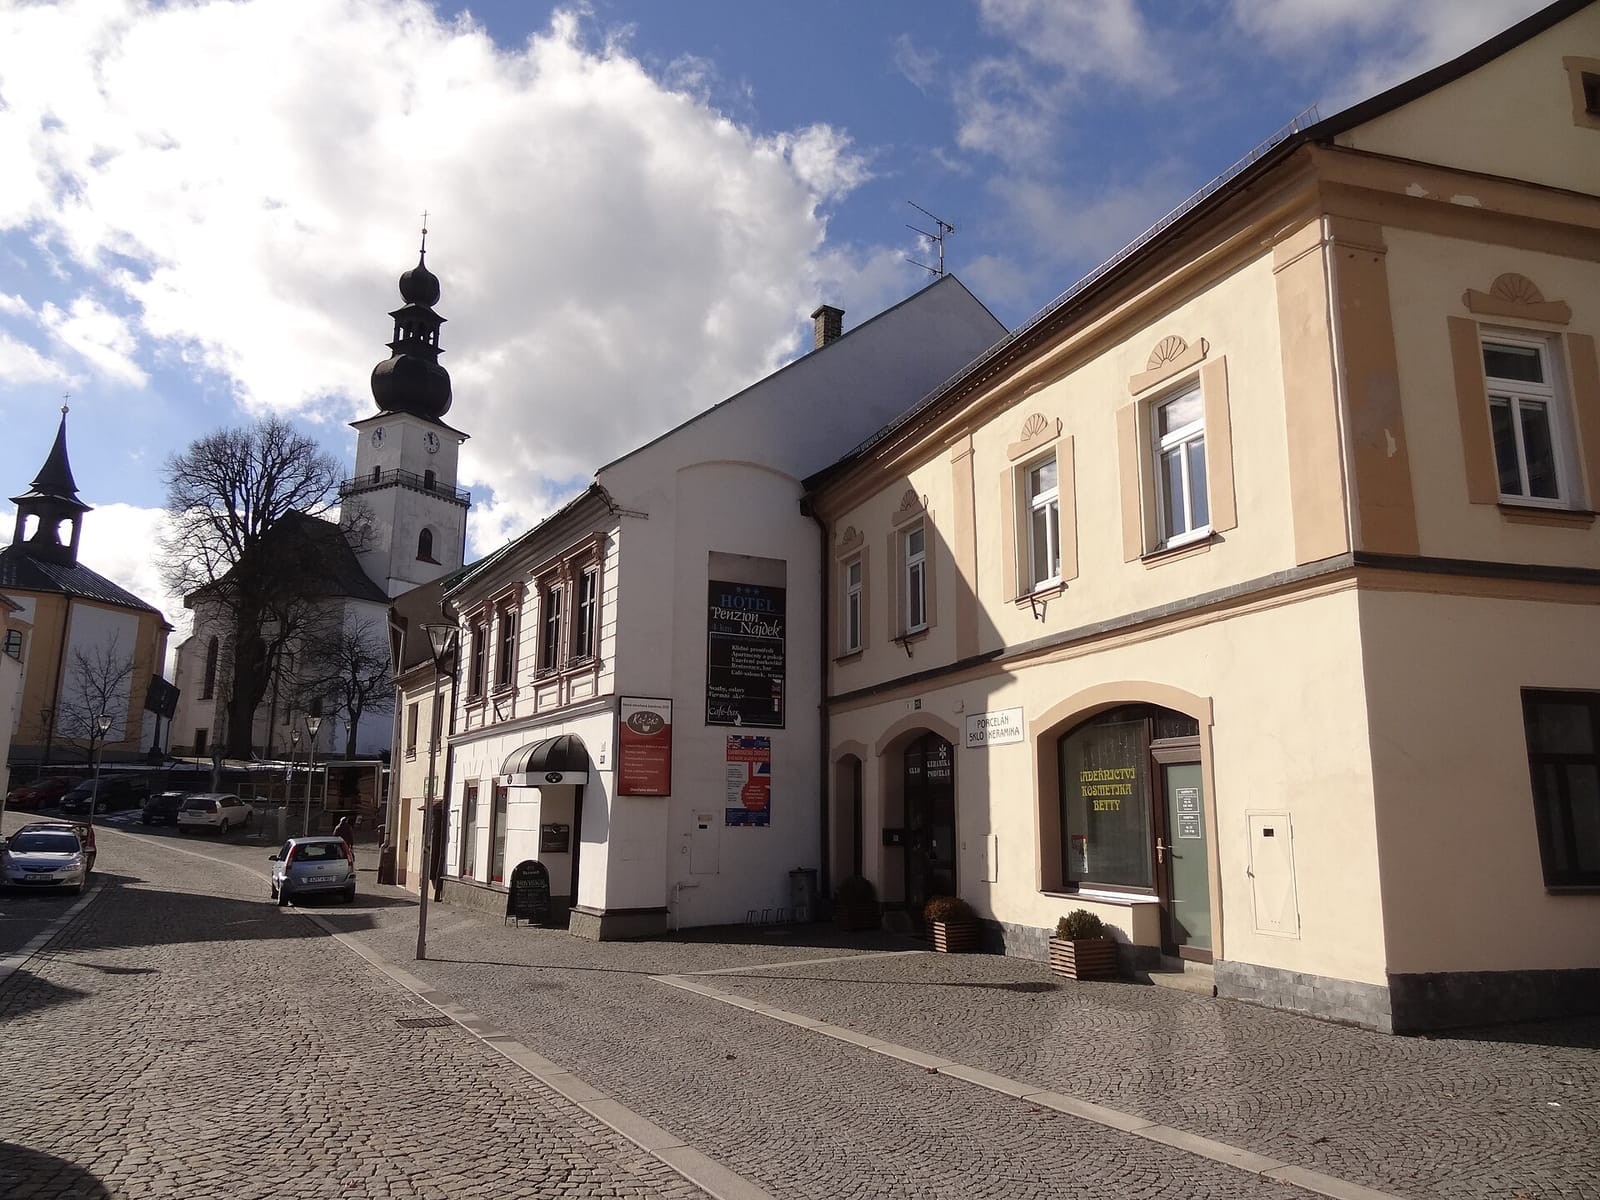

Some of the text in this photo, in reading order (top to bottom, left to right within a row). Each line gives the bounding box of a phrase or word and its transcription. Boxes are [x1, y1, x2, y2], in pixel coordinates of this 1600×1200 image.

[720, 594, 776, 612] HOTEL
[977, 713, 1009, 729] PORCELÁN
[969, 732, 984, 742] SKLO
[1092, 799, 1120, 811] BETTY
